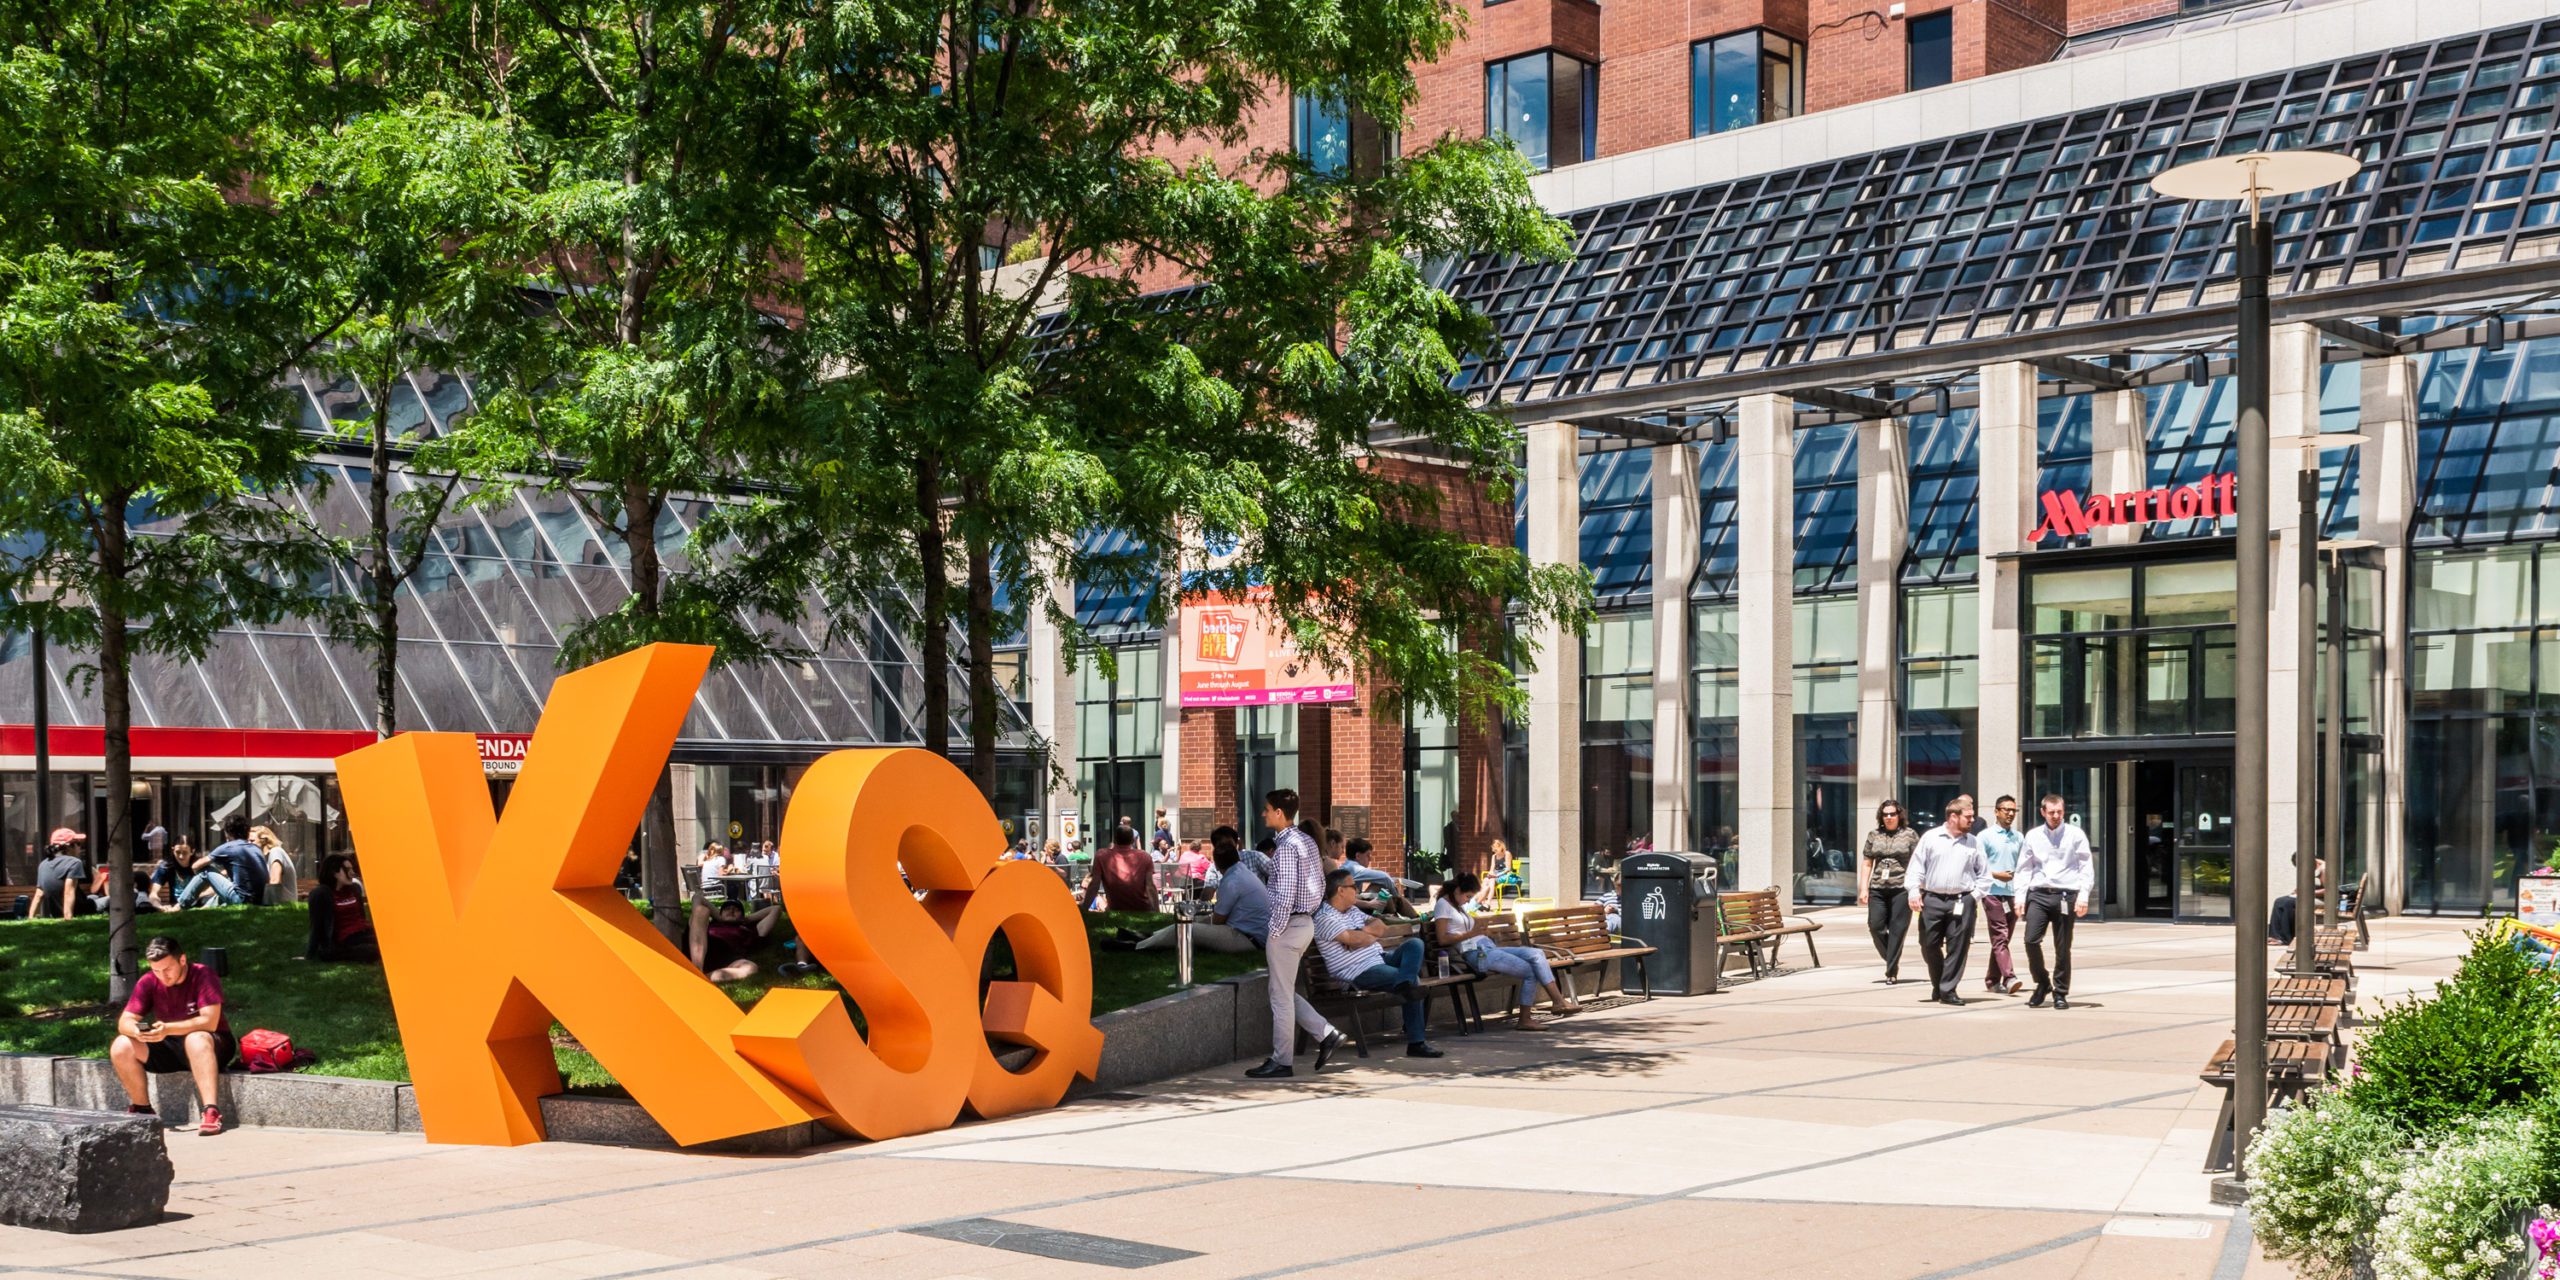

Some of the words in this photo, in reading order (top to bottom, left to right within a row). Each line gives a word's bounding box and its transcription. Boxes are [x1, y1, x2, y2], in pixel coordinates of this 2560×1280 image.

[2027, 472, 2238, 543] Marriott
[1203, 634, 1227, 644] AFTER
[1203, 643, 1227, 657] FIVE
[1210, 681, 1231, 690] through
[1231, 681, 1249, 689] August
